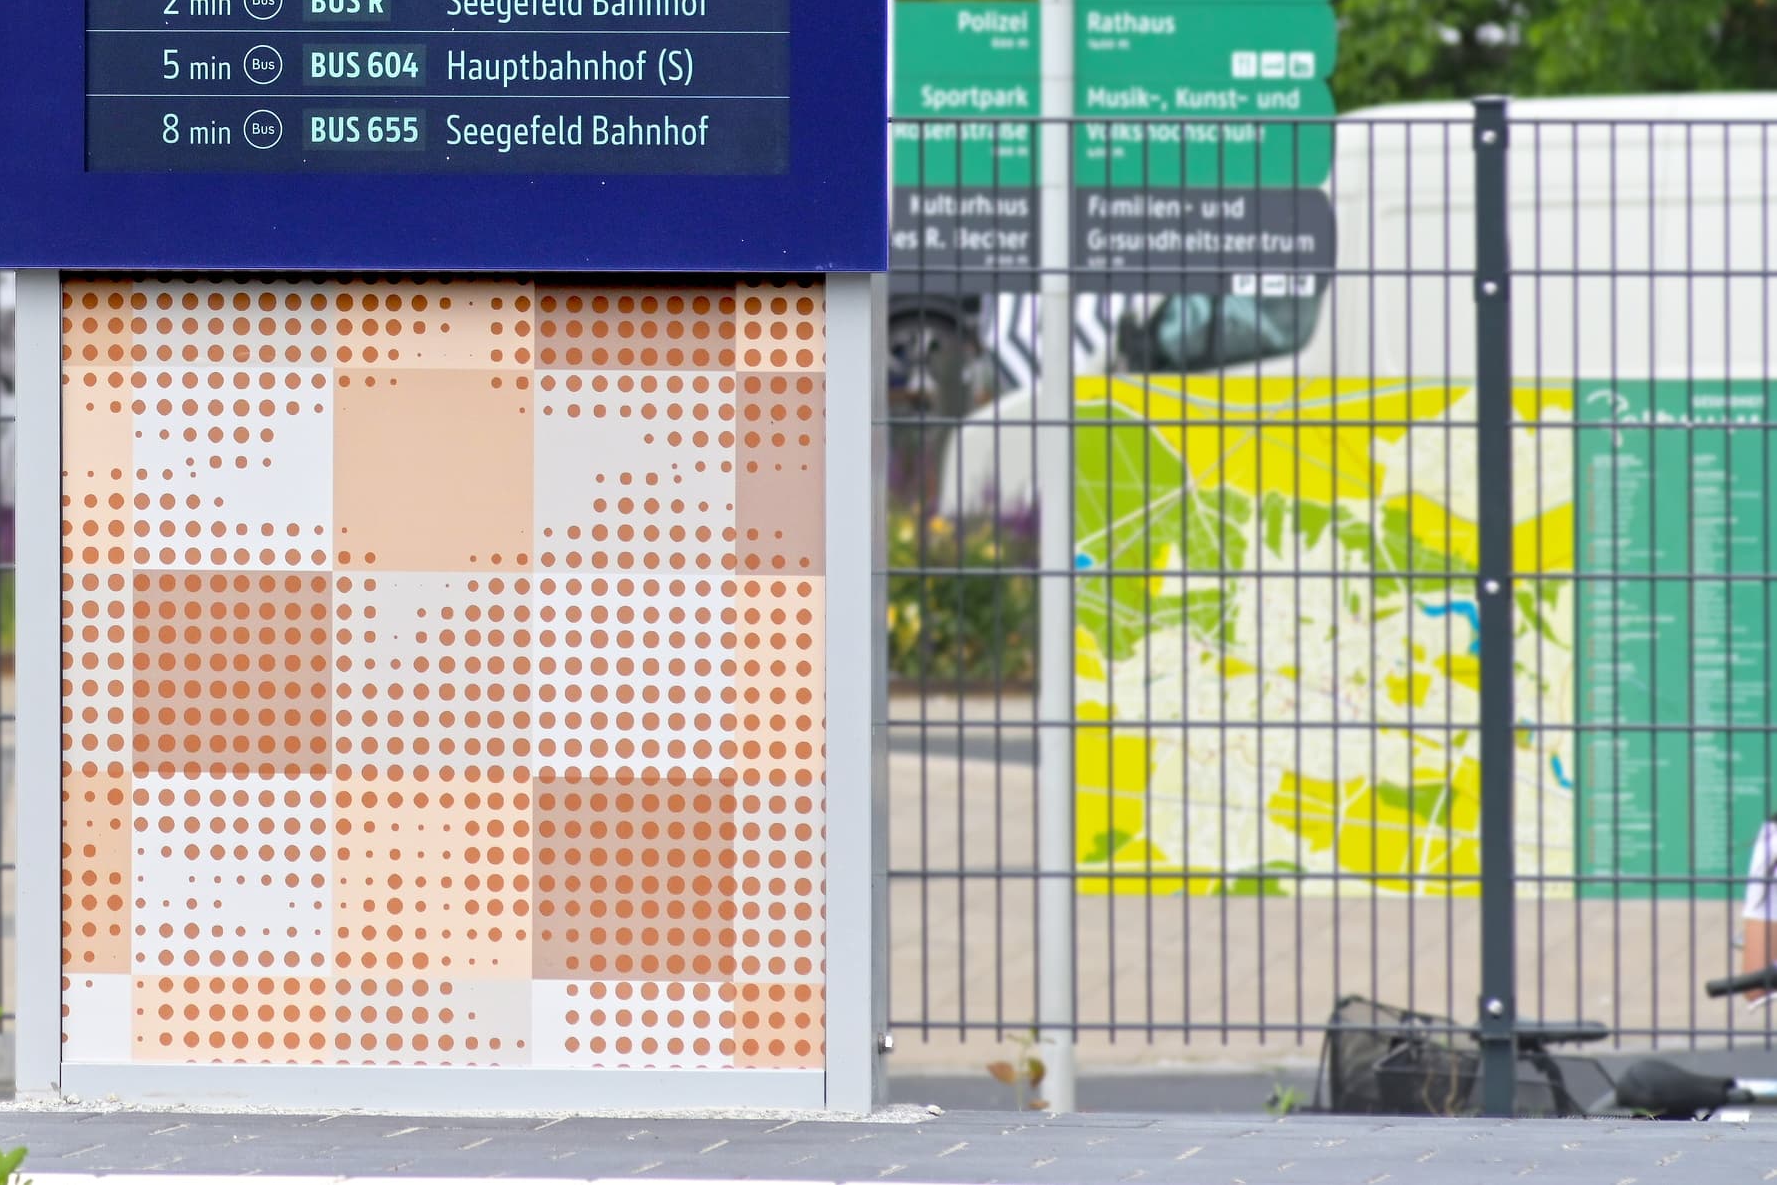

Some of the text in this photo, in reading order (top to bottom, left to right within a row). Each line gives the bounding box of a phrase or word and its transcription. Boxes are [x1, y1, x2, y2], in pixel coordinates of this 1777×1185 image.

[957, 10, 1028, 32] Polizei
[1087, 11, 1176, 33] Rathaus
[163, 47, 693, 88] 5 min Bus BUS 604 Hauptbahnhof (S)
[921, 85, 1029, 110] Sportpark
[1087, 88, 1300, 111] Musik-, Kunst- und
[163, 113, 710, 153] 8 min Bus BUS 655 Seegefeld Bahnhof
